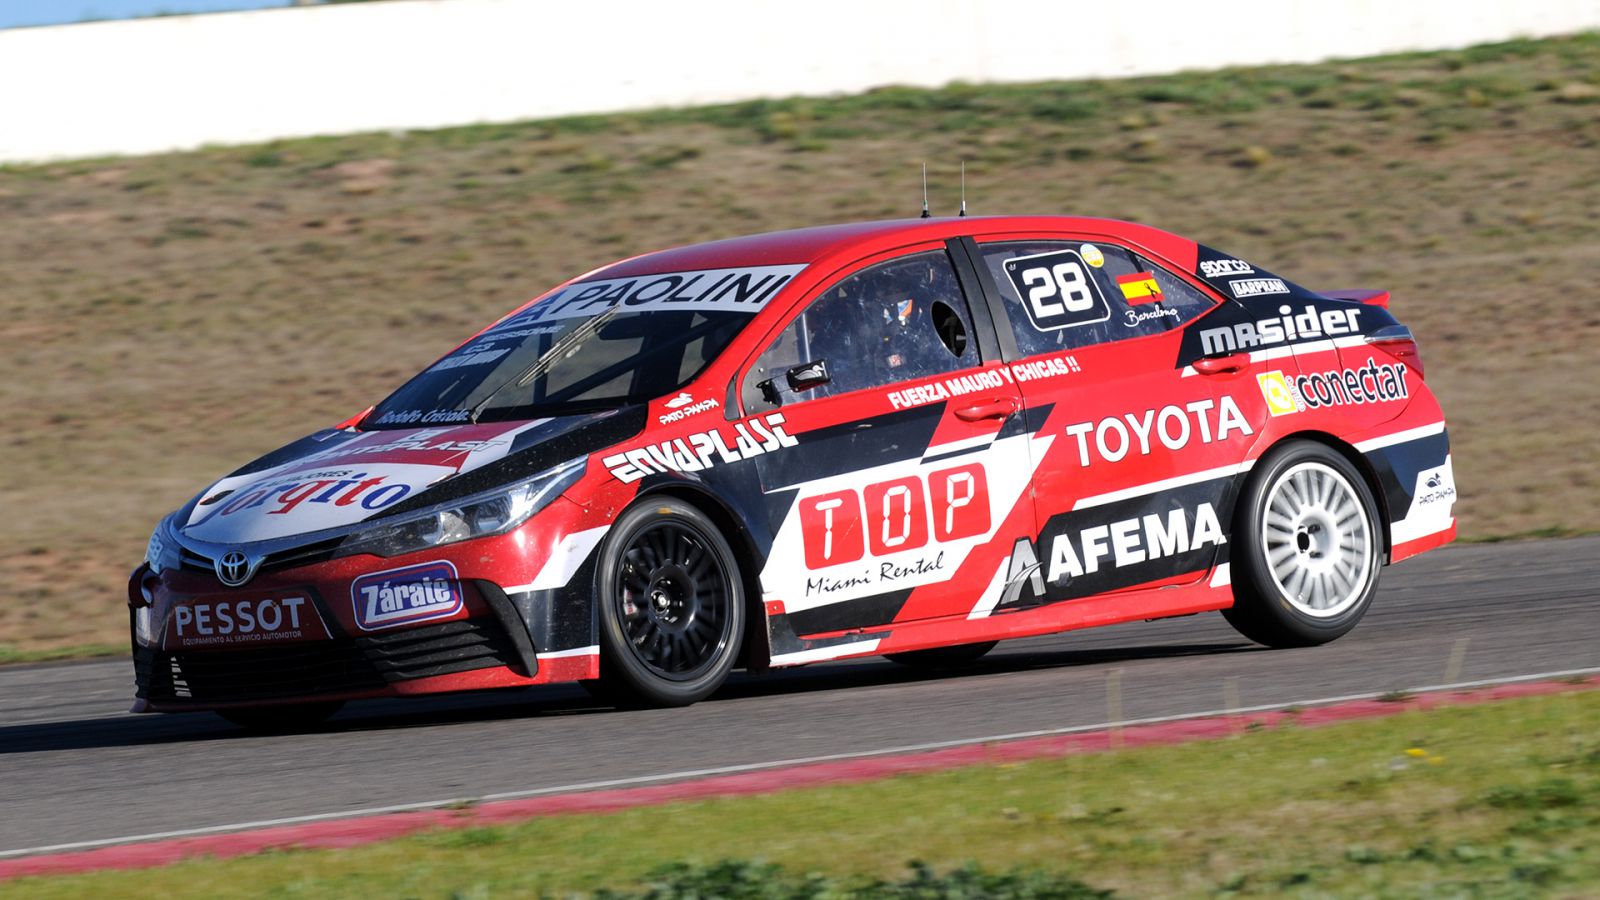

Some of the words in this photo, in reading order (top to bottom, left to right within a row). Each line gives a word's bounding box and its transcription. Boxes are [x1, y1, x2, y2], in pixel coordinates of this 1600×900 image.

[1021, 261, 1094, 319] 28
[1200, 259, 1251, 277] sparco
[1232, 281, 1286, 296] BARPRAN
[550, 273, 793, 315] PAOLINI
[1123, 304, 1181, 328] Barcelona
[887, 382, 949, 410] FUERZA
[948, 370, 1004, 397] MAURO
[999, 367, 1014, 385] Y
[1013, 358, 1070, 383] CHICAS
[1296, 356, 1410, 408] conectar
[659, 409, 685, 425] PATO
[683, 397, 720, 417] PAMPA
[1065, 395, 1255, 468] TOYOTA
[602, 412, 800, 485] ENVAPLAST
[814, 471, 975, 561] TOP
[1046, 501, 1228, 583] AFEMA
[805, 570, 872, 597] Miami
[880, 550, 945, 581] Rental
[174, 597, 305, 637] PESSOT
[360, 576, 456, 624] Zárate
[183, 636, 225, 646] EQUIPAMIENTO
[235, 633, 261, 643] SERVICIO
[262, 630, 303, 641] AUTOMOTOR
